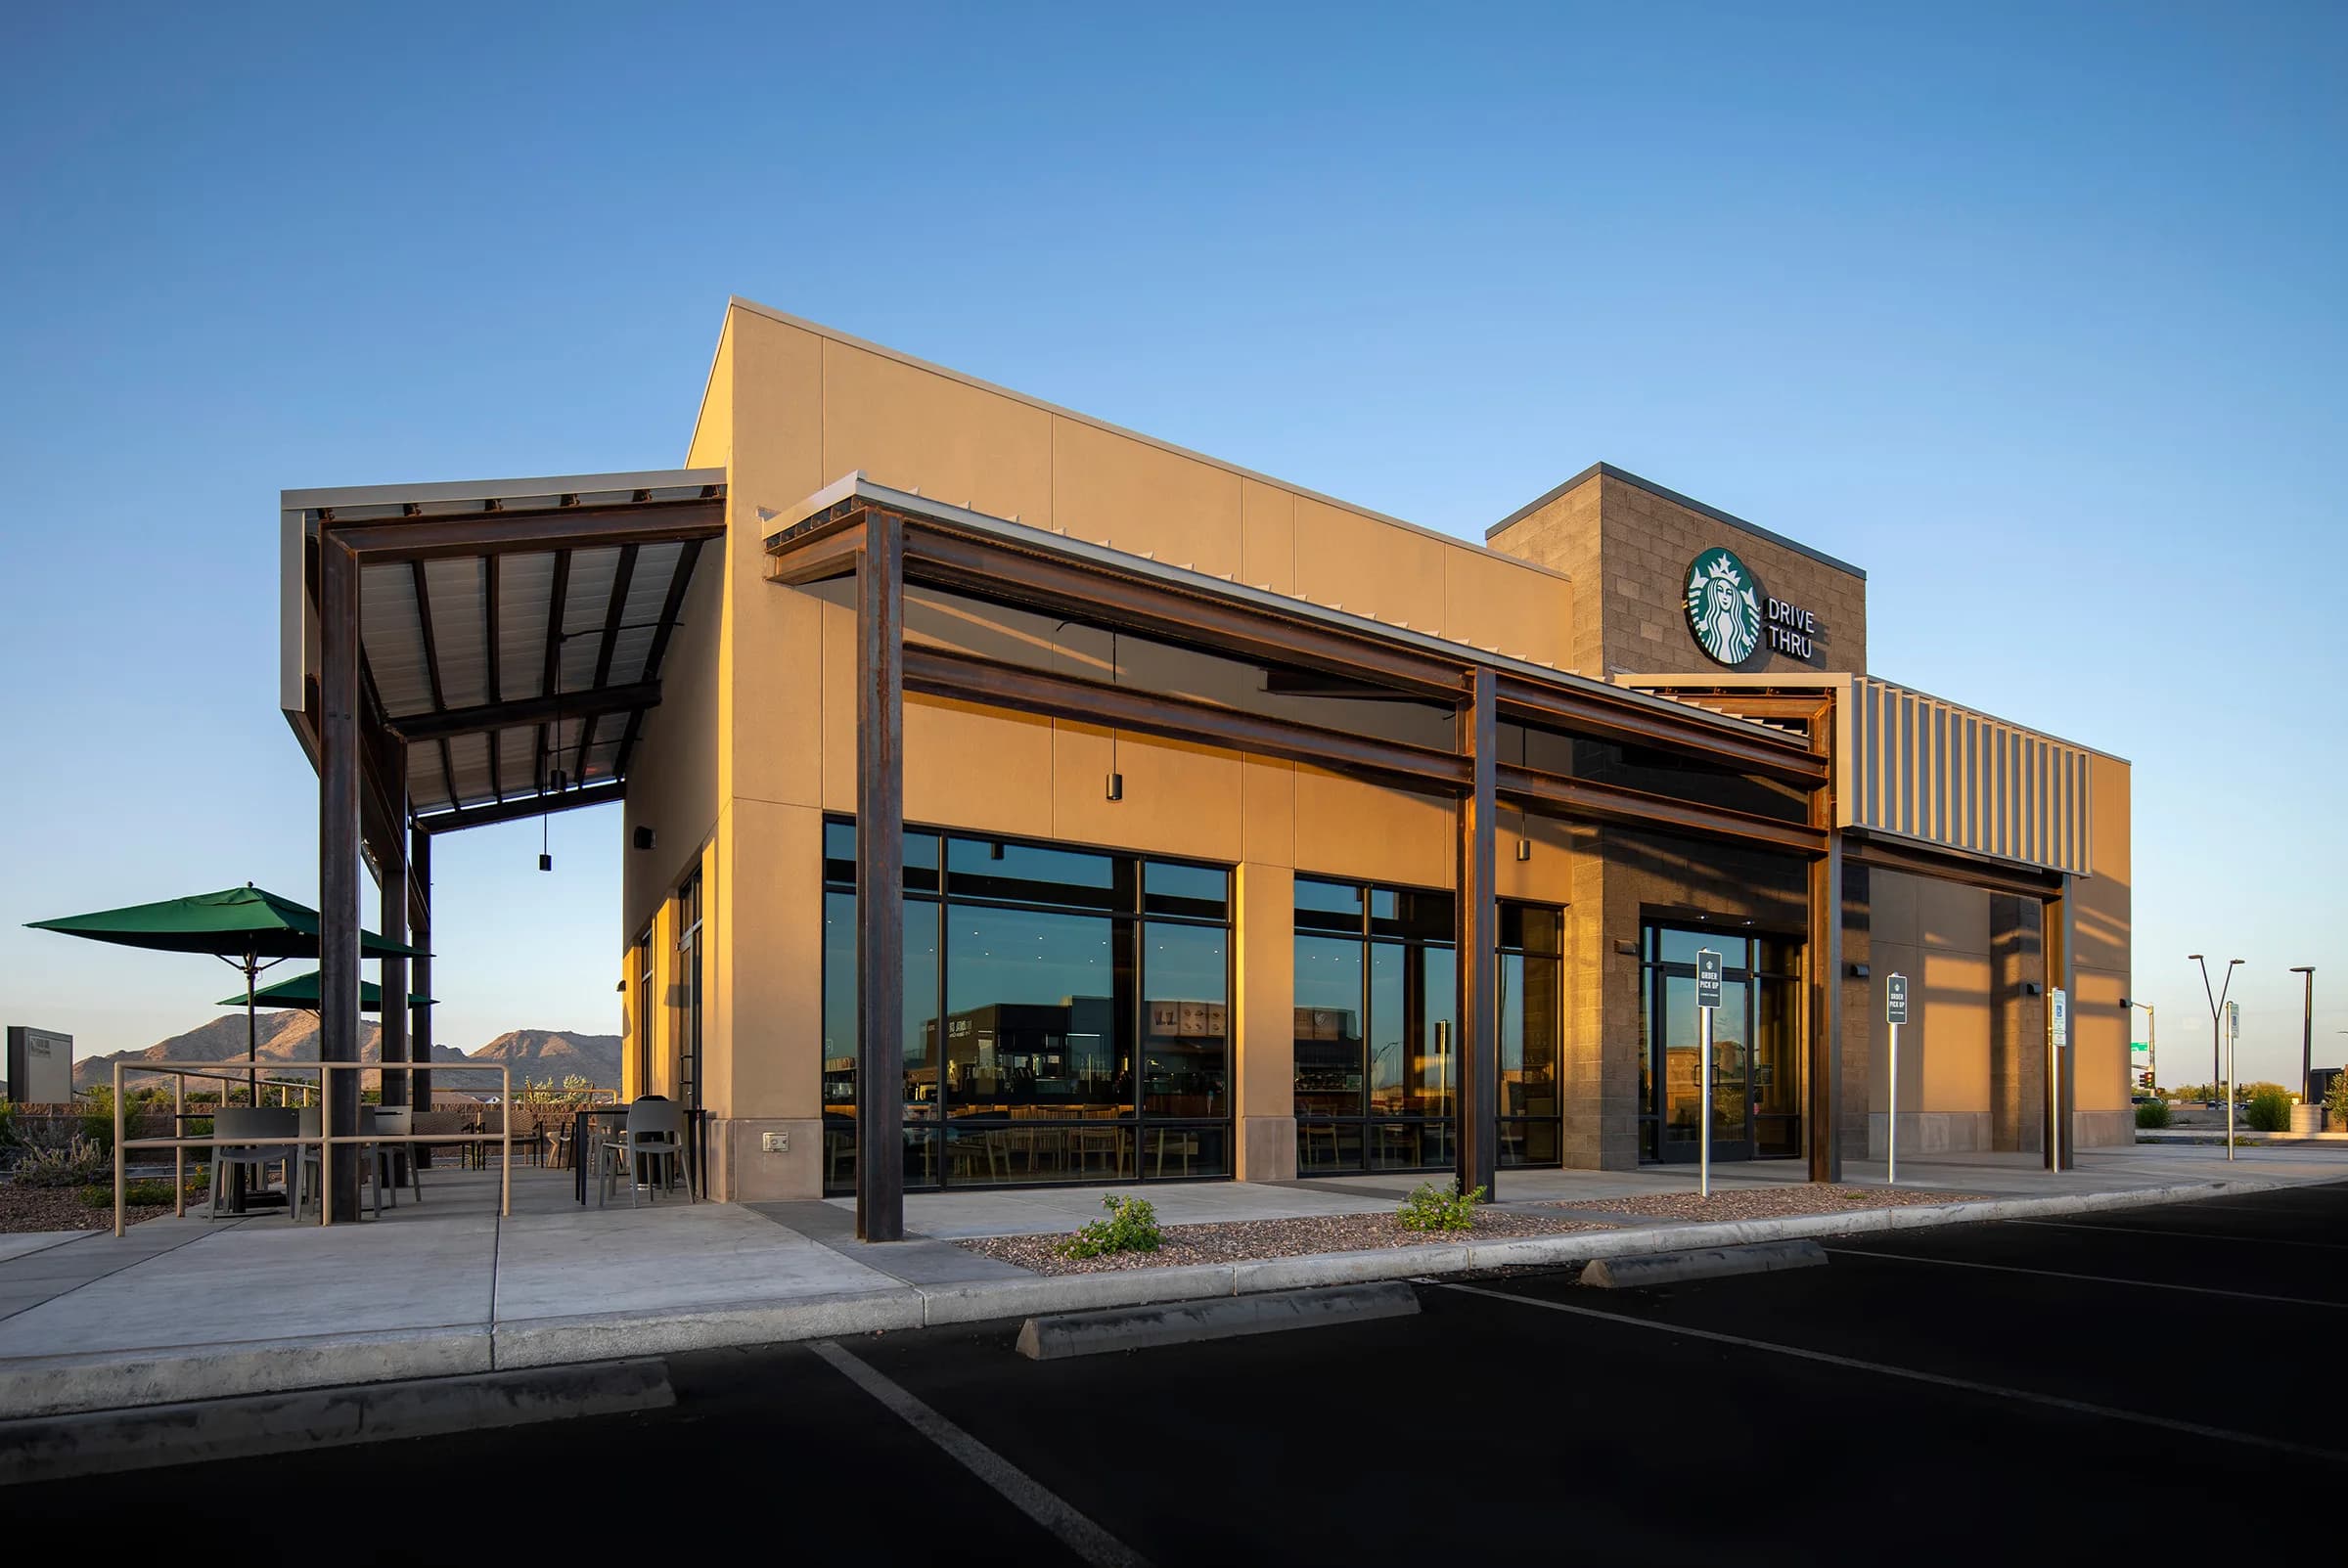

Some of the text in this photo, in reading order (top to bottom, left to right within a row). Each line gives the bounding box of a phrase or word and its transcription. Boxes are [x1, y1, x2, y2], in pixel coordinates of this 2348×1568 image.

[1768, 598, 1815, 634] DRIVE
[1768, 625, 1812, 658] THRU
[1699, 980, 1711, 989] PICK
[1700, 971, 1718, 980] ORDER
